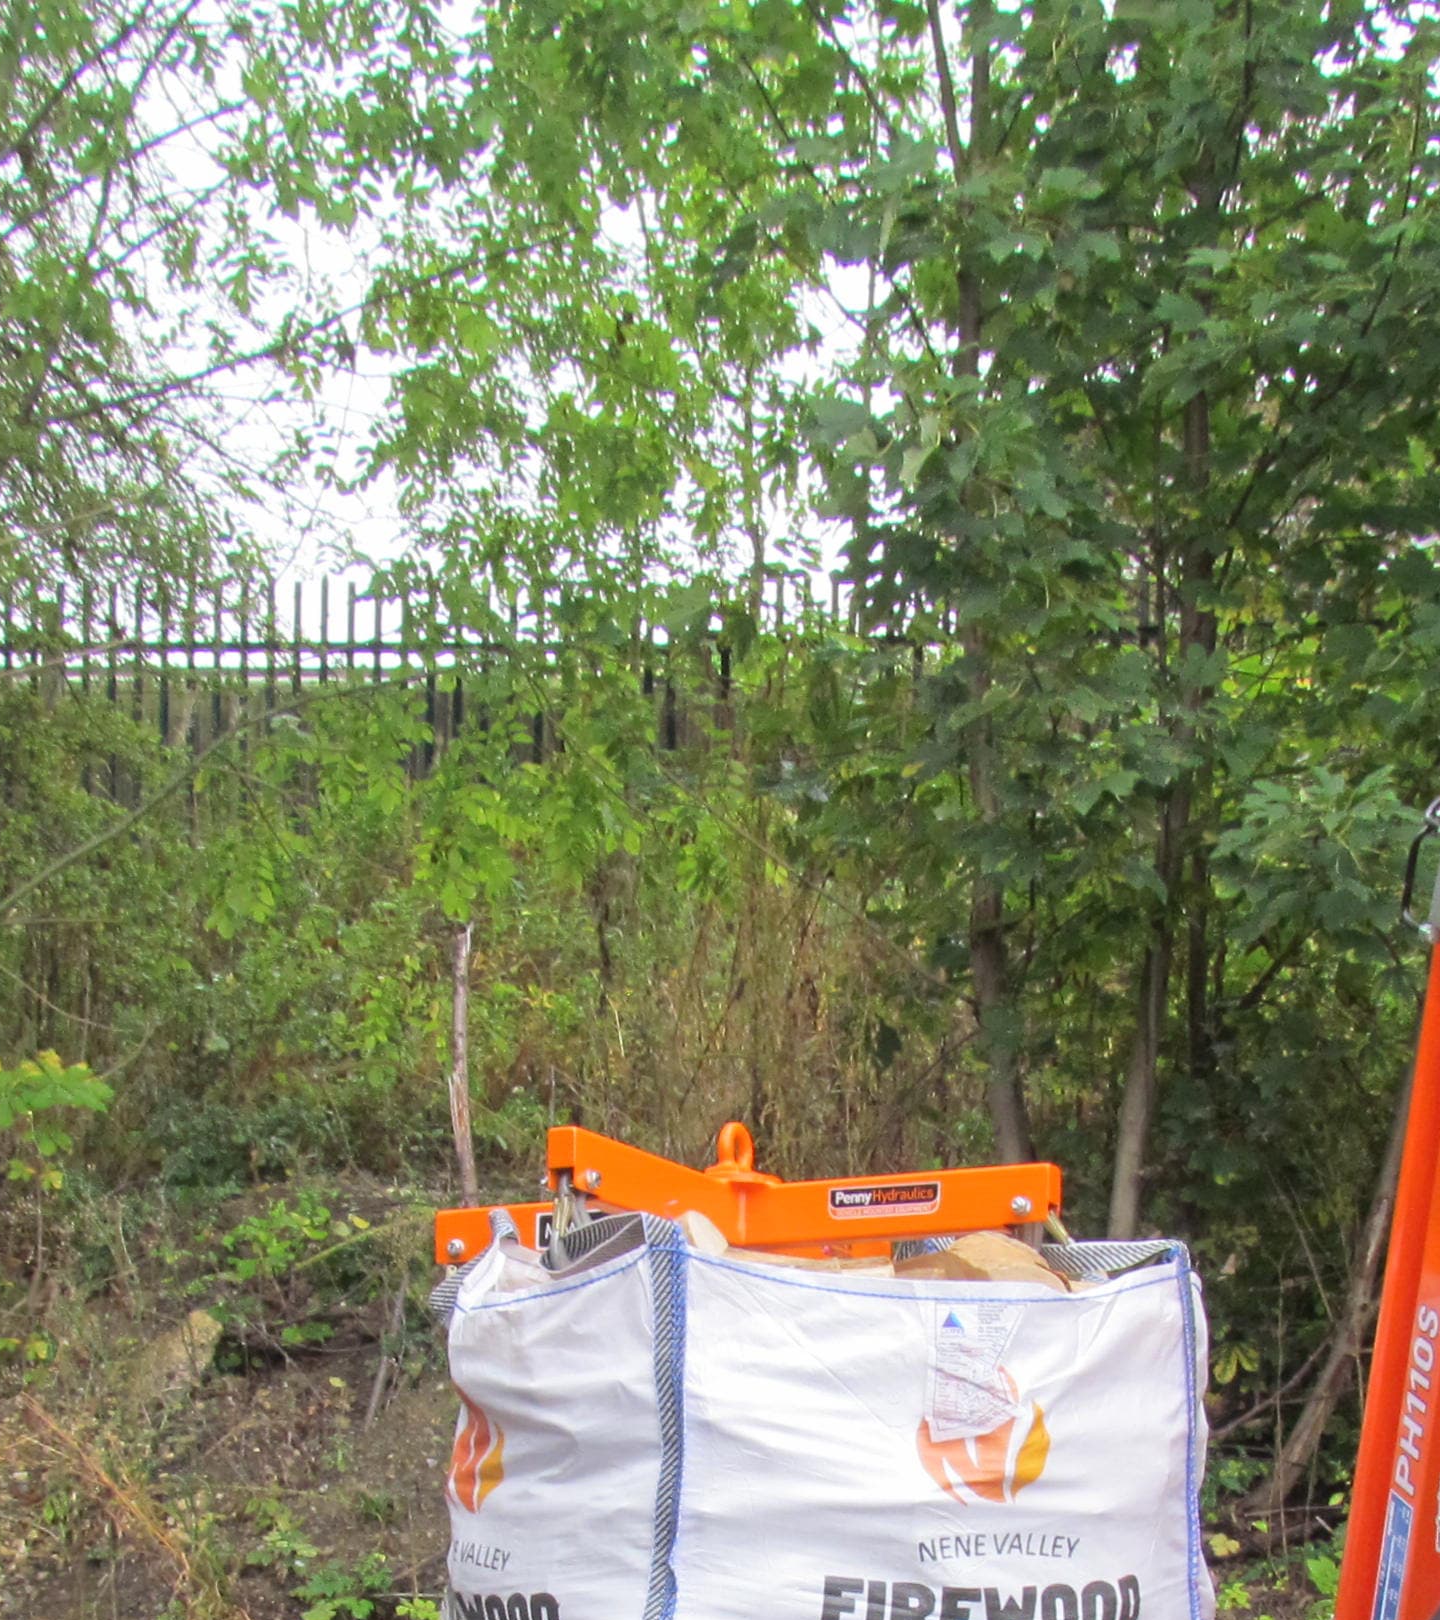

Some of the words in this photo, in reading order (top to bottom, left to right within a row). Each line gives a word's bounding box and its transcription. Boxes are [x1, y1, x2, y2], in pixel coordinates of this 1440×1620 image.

[1395, 1305, 1440, 1497] PH110S
[460, 1541, 511, 1571] VALLEY
[918, 1534, 987, 1562] NENE
[993, 1533, 1080, 1558] VALLEY
